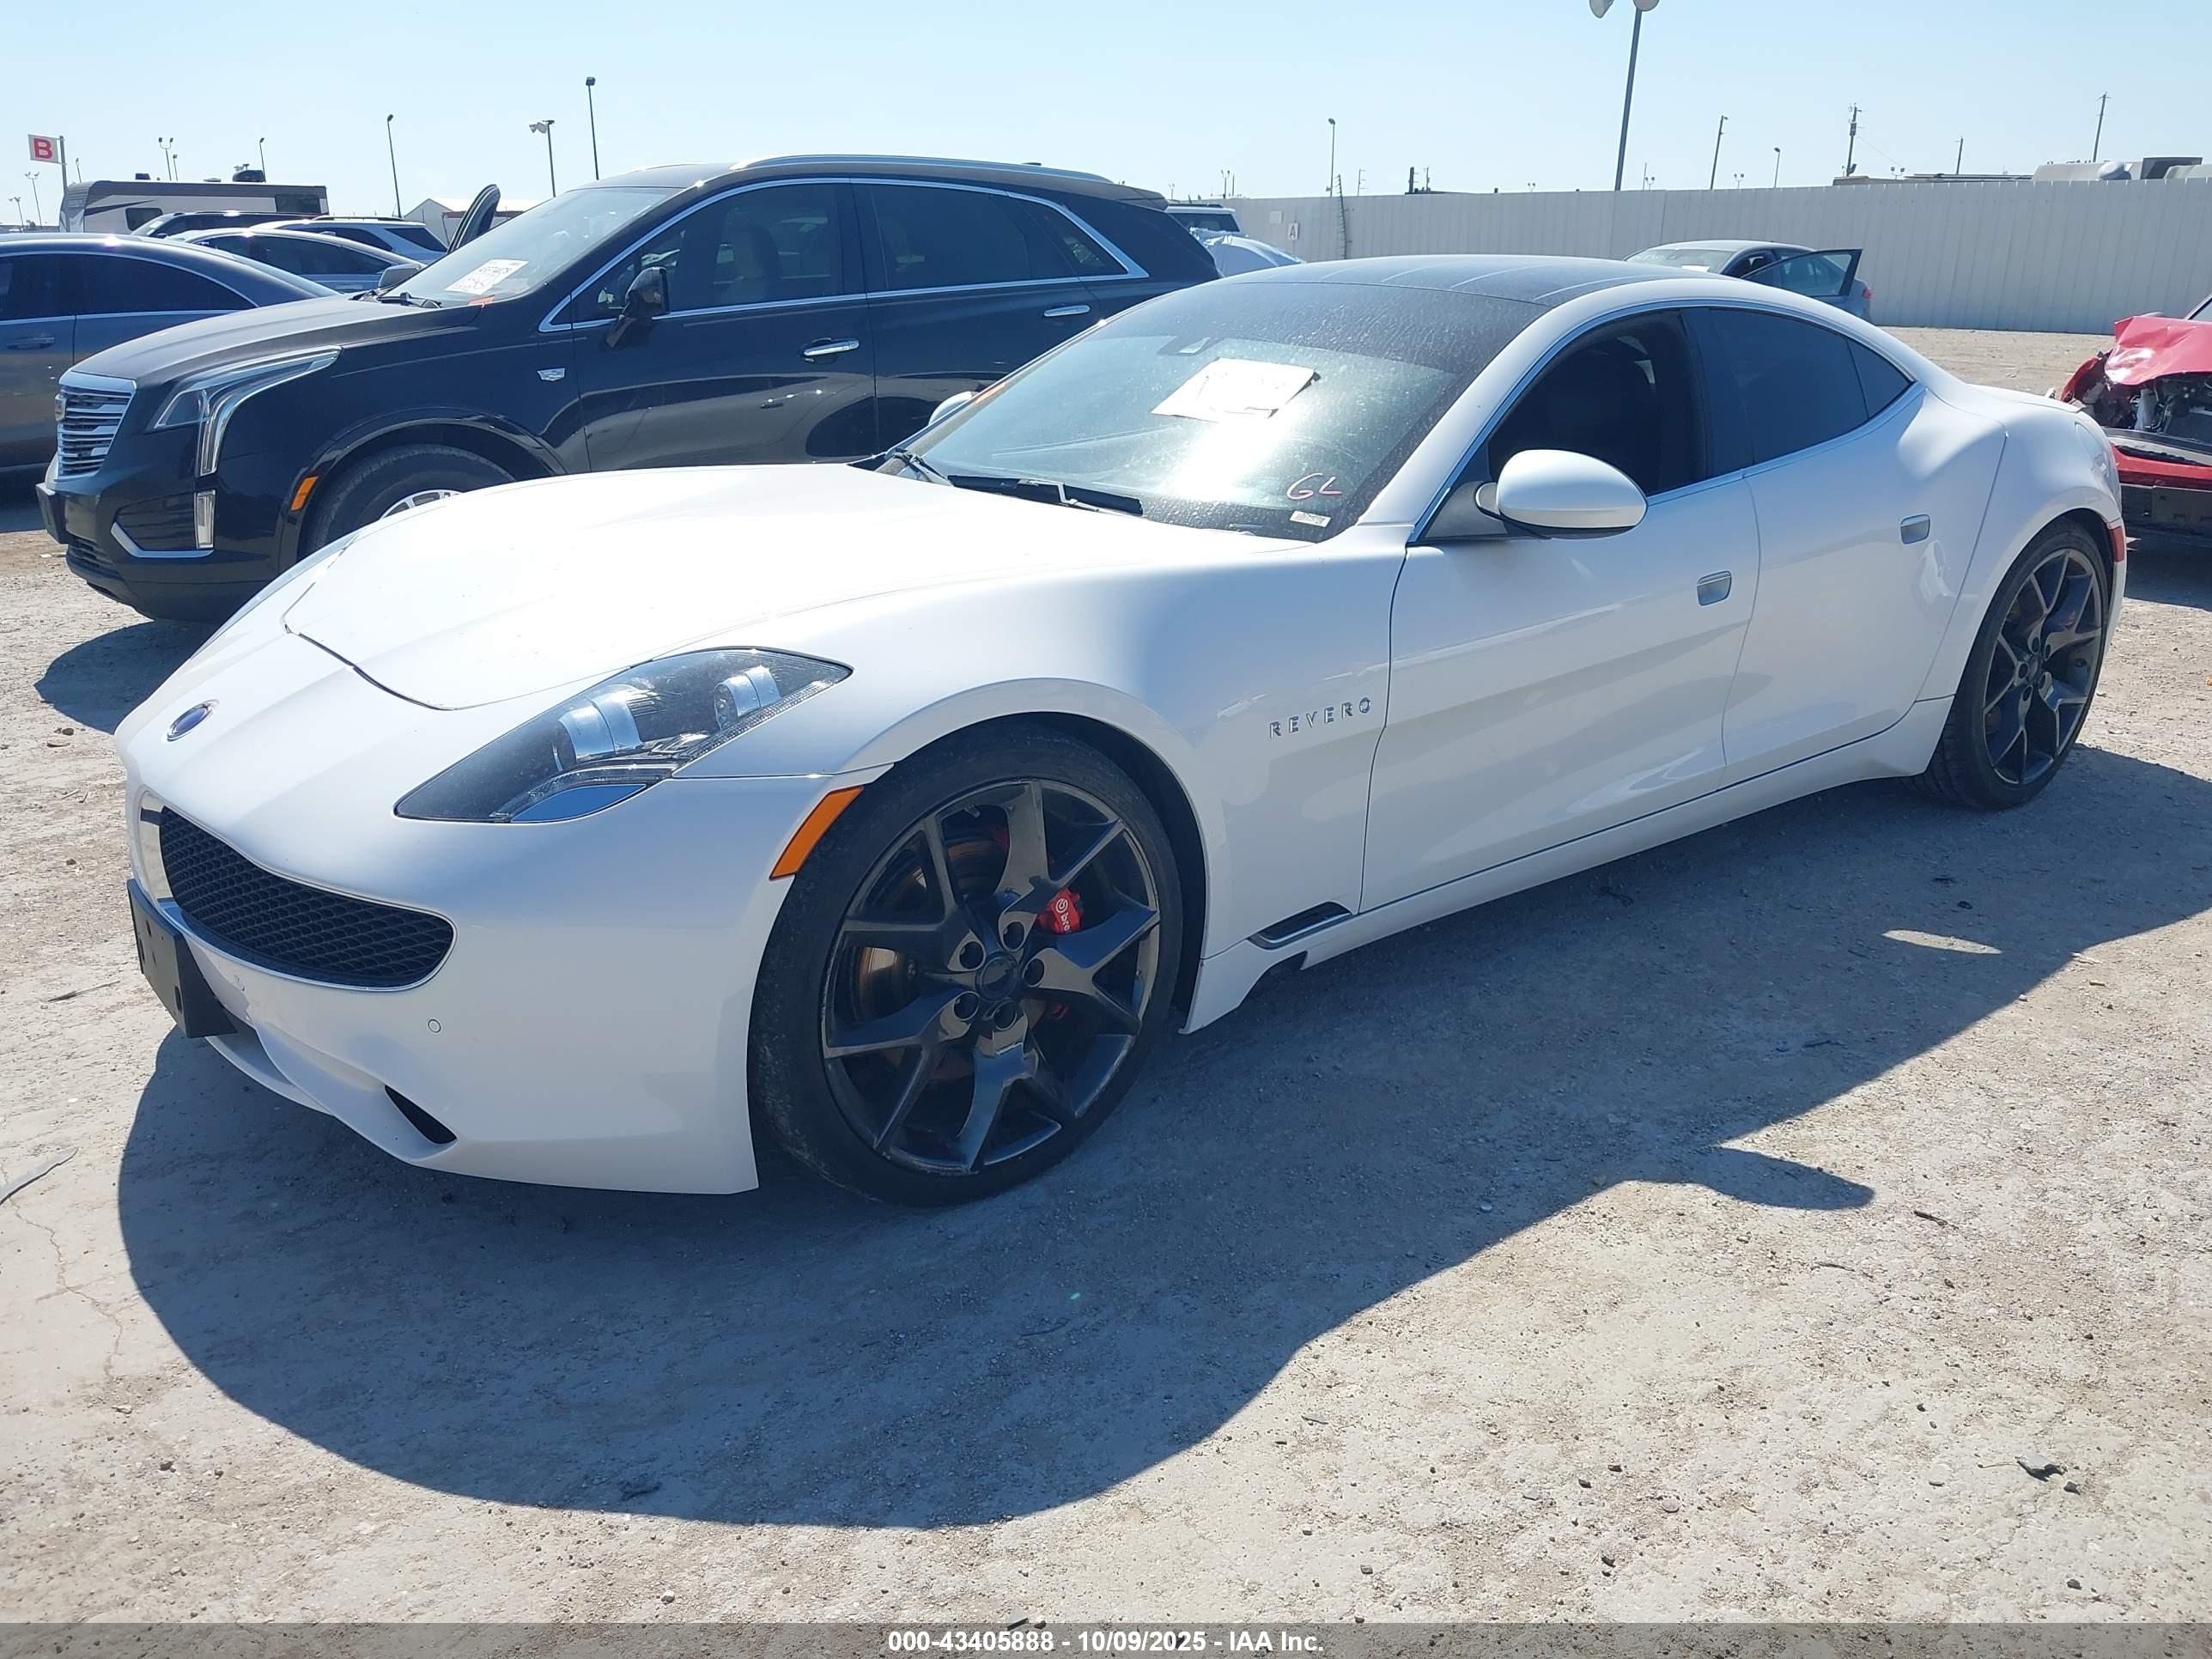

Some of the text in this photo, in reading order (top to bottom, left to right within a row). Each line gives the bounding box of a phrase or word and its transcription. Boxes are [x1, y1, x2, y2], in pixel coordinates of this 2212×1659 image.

[33, 137, 53, 159] B
[1290, 224, 1297, 239] A
[1269, 696, 1371, 739] REVERO
